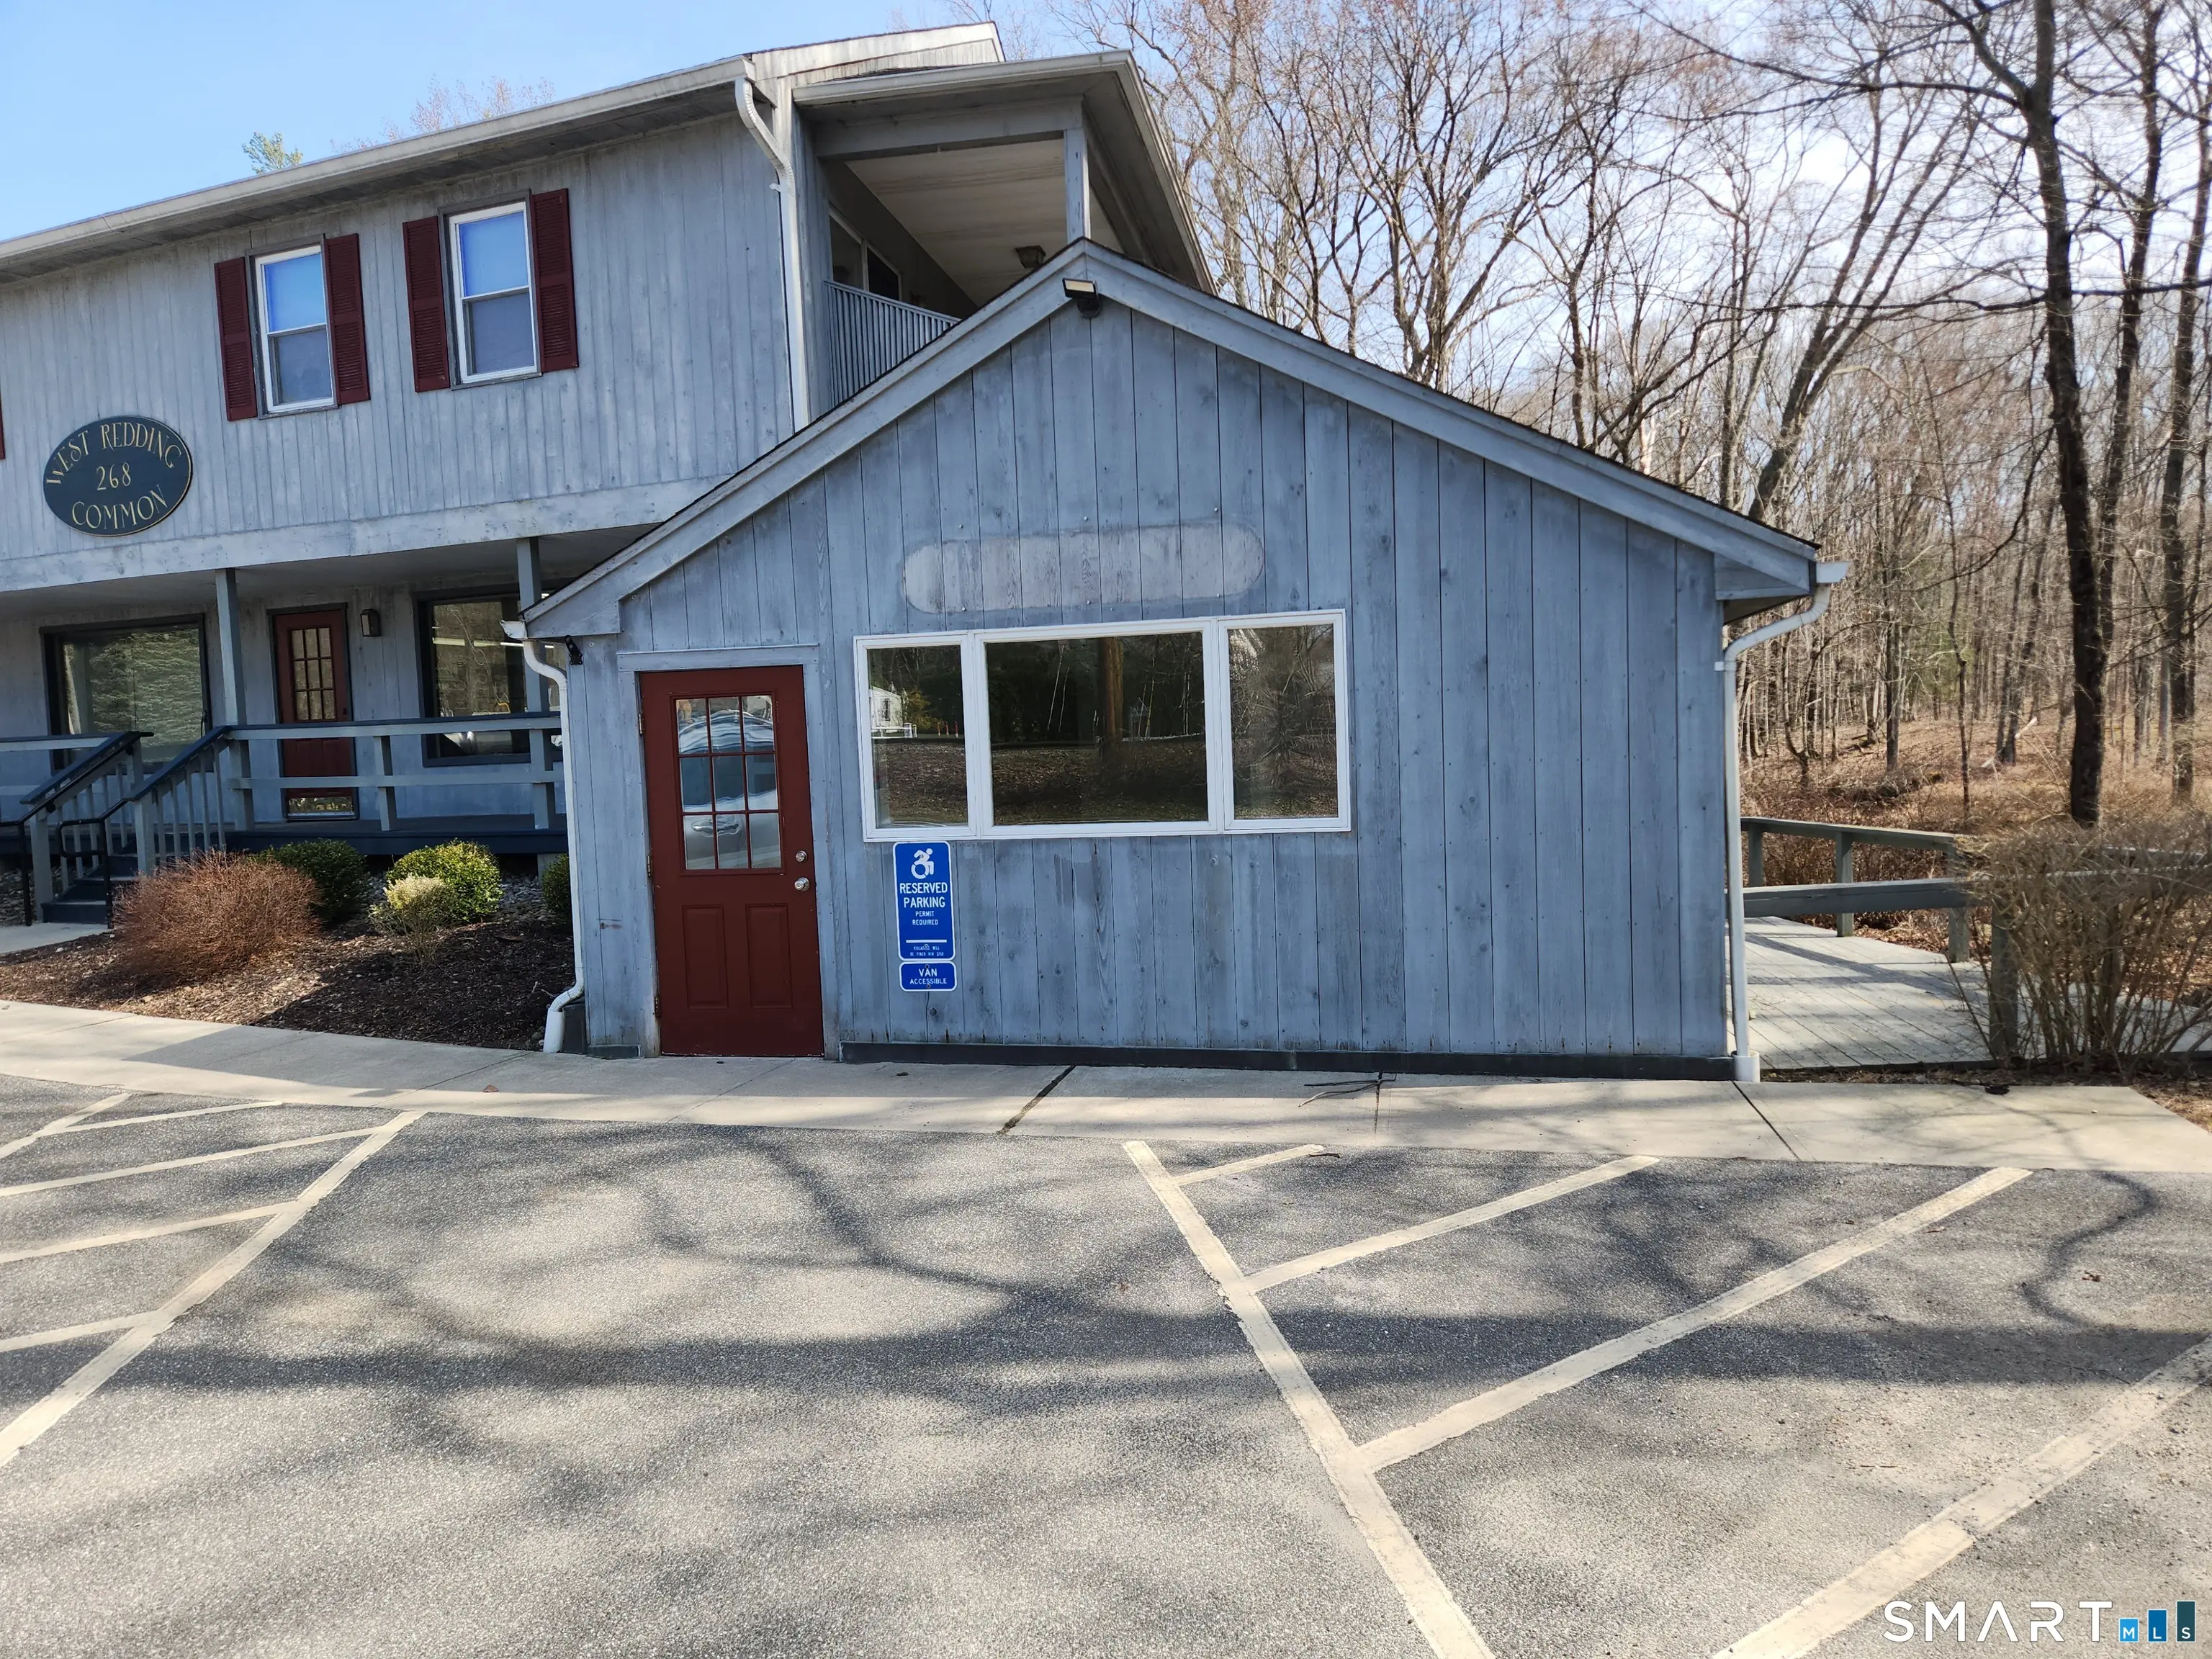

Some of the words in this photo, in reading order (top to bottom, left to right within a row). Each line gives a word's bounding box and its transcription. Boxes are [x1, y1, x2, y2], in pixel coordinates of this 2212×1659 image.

[46, 430, 89, 485] WEST
[100, 422, 182, 469] REDDING
[96, 462, 132, 491] 268
[72, 484, 168, 530] COMMON
[899, 882, 948, 894] RESERVED
[904, 896, 945, 908] PARKING
[918, 968, 938, 977] VAN
